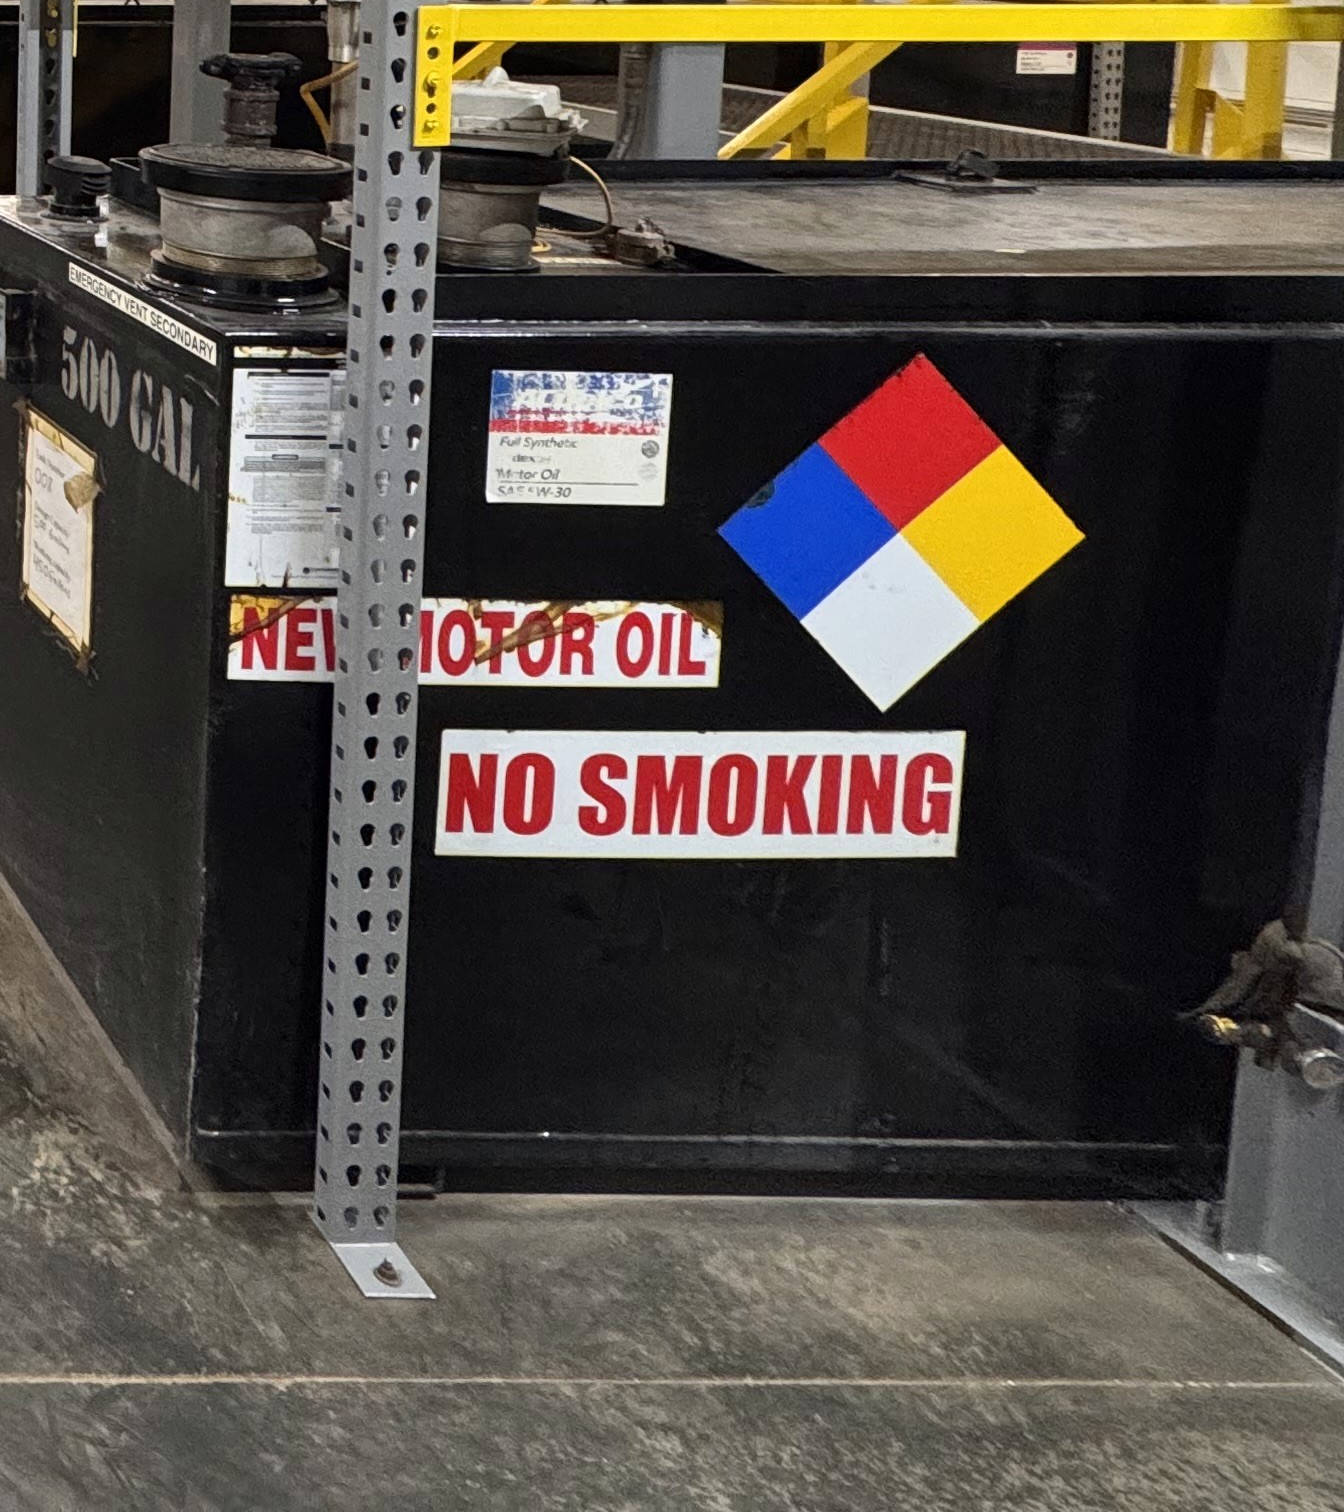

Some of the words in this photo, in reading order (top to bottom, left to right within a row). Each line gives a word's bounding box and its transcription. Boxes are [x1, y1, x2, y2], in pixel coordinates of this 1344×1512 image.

[69, 266, 123, 307] EMERGENCY
[123, 296, 150, 322] VENT
[150, 311, 214, 361] SECONDARY
[62, 325, 121, 429] 500
[129, 368, 200, 493] GAL
[540, 468, 561, 481] Oil
[241, 607, 337, 672] NE
[616, 610, 707, 678] OIL
[444, 752, 555, 836] NO
[577, 752, 954, 837] SMOKING
